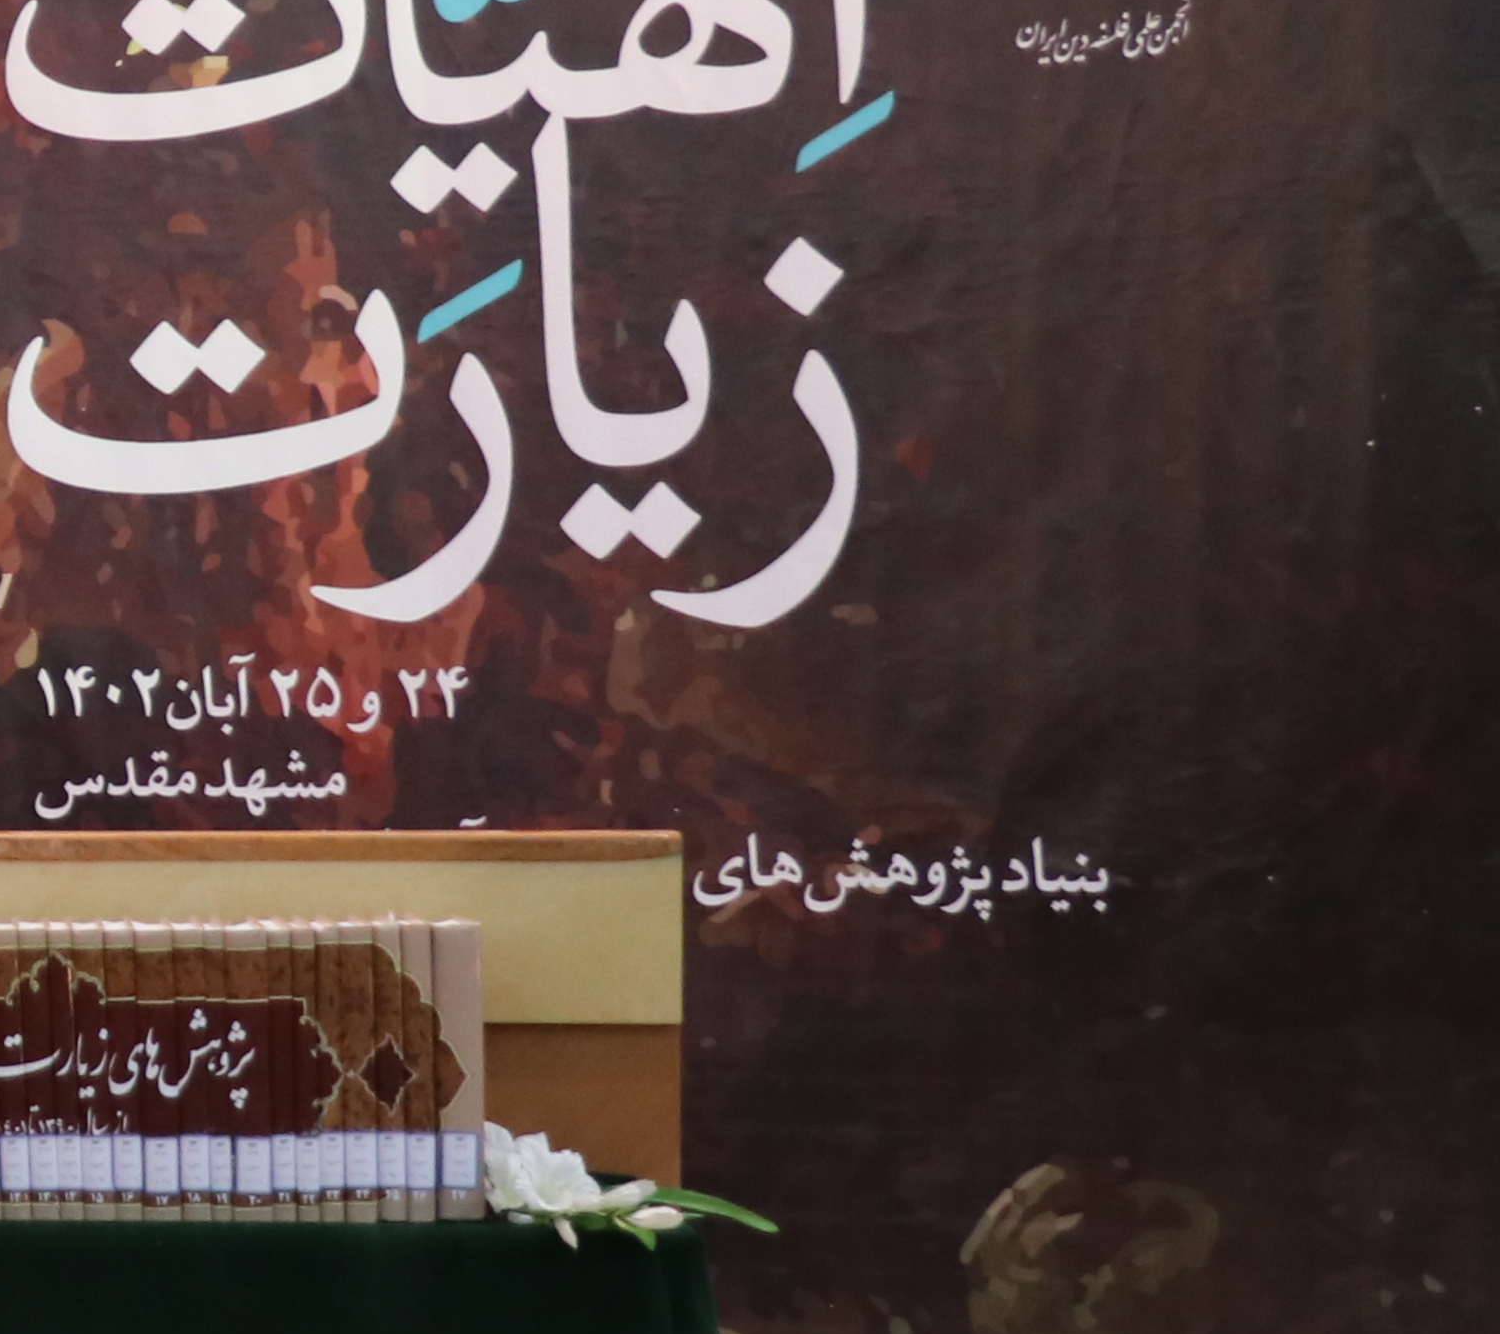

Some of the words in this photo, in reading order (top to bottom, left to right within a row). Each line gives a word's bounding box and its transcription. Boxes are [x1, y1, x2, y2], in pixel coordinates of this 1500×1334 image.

[36, 665, 162, 719] ۱۴۰۲
[165, 652, 257, 735] آبان
[269, 666, 342, 719] ۲۵
[346, 690, 382, 733] و
[397, 665, 469, 719] ۲۴
[33, 749, 198, 820] مقدس
[203, 748, 348, 818] مشهد
[692, 832, 803, 907] های
[803, 837, 993, 923] پژوهش
[1001, 835, 1110, 913] بنیاد
